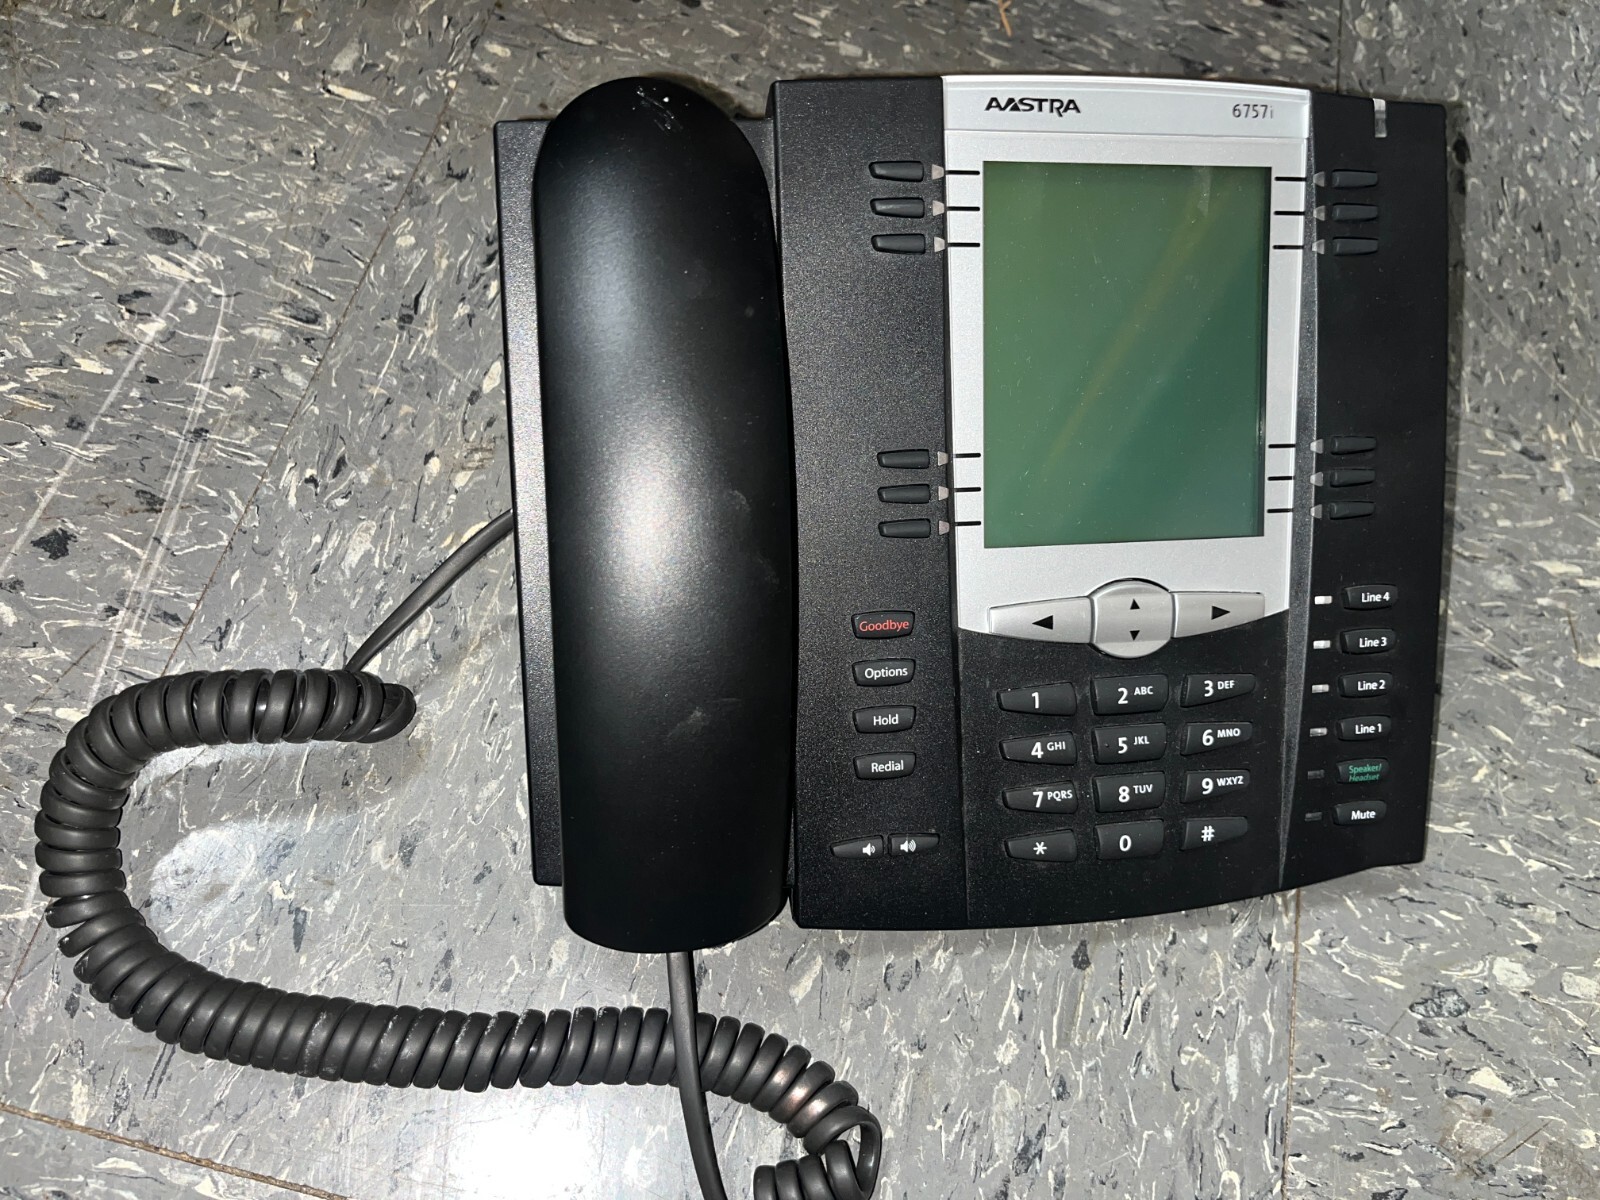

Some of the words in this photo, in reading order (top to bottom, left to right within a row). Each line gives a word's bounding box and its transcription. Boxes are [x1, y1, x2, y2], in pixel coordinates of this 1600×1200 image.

[1232, 103, 1274, 120] 6757i
[1361, 592, 1383, 603] Line
[1383, 592, 1390, 602] 4
[859, 619, 910, 632] Goodbye
[1359, 637, 1380, 648] Line
[1380, 637, 1388, 647] 3
[864, 667, 908, 680] Options
[1203, 680, 1214, 697] 3
[1217, 680, 1235, 690] DEF
[1357, 680, 1378, 691] Line
[1378, 680, 1386, 690] 2
[1031, 691, 1040, 709] 1
[1117, 687, 1129, 705] 2
[1133, 686, 1154, 696] ABC
[873, 713, 899, 726] Hold
[1201, 729, 1214, 746] 6
[1217, 728, 1241, 738] MNO
[1355, 724, 1376, 735] Line
[1376, 723, 1382, 733] 1
[1030, 741, 1044, 759] 4
[1046, 741, 1066, 751] GHI
[1117, 737, 1128, 754] 5
[1133, 735, 1150, 746] JKL
[871, 759, 904, 773] Redial
[1118, 785, 1130, 803] 8
[1133, 784, 1153, 795] TUV
[1201, 778, 1214, 795] 9
[1216, 775, 1244, 787] WXYZ
[1032, 791, 1044, 808] 7
[1047, 789, 1073, 802] PQRS
[1351, 810, 1376, 821] Mute
